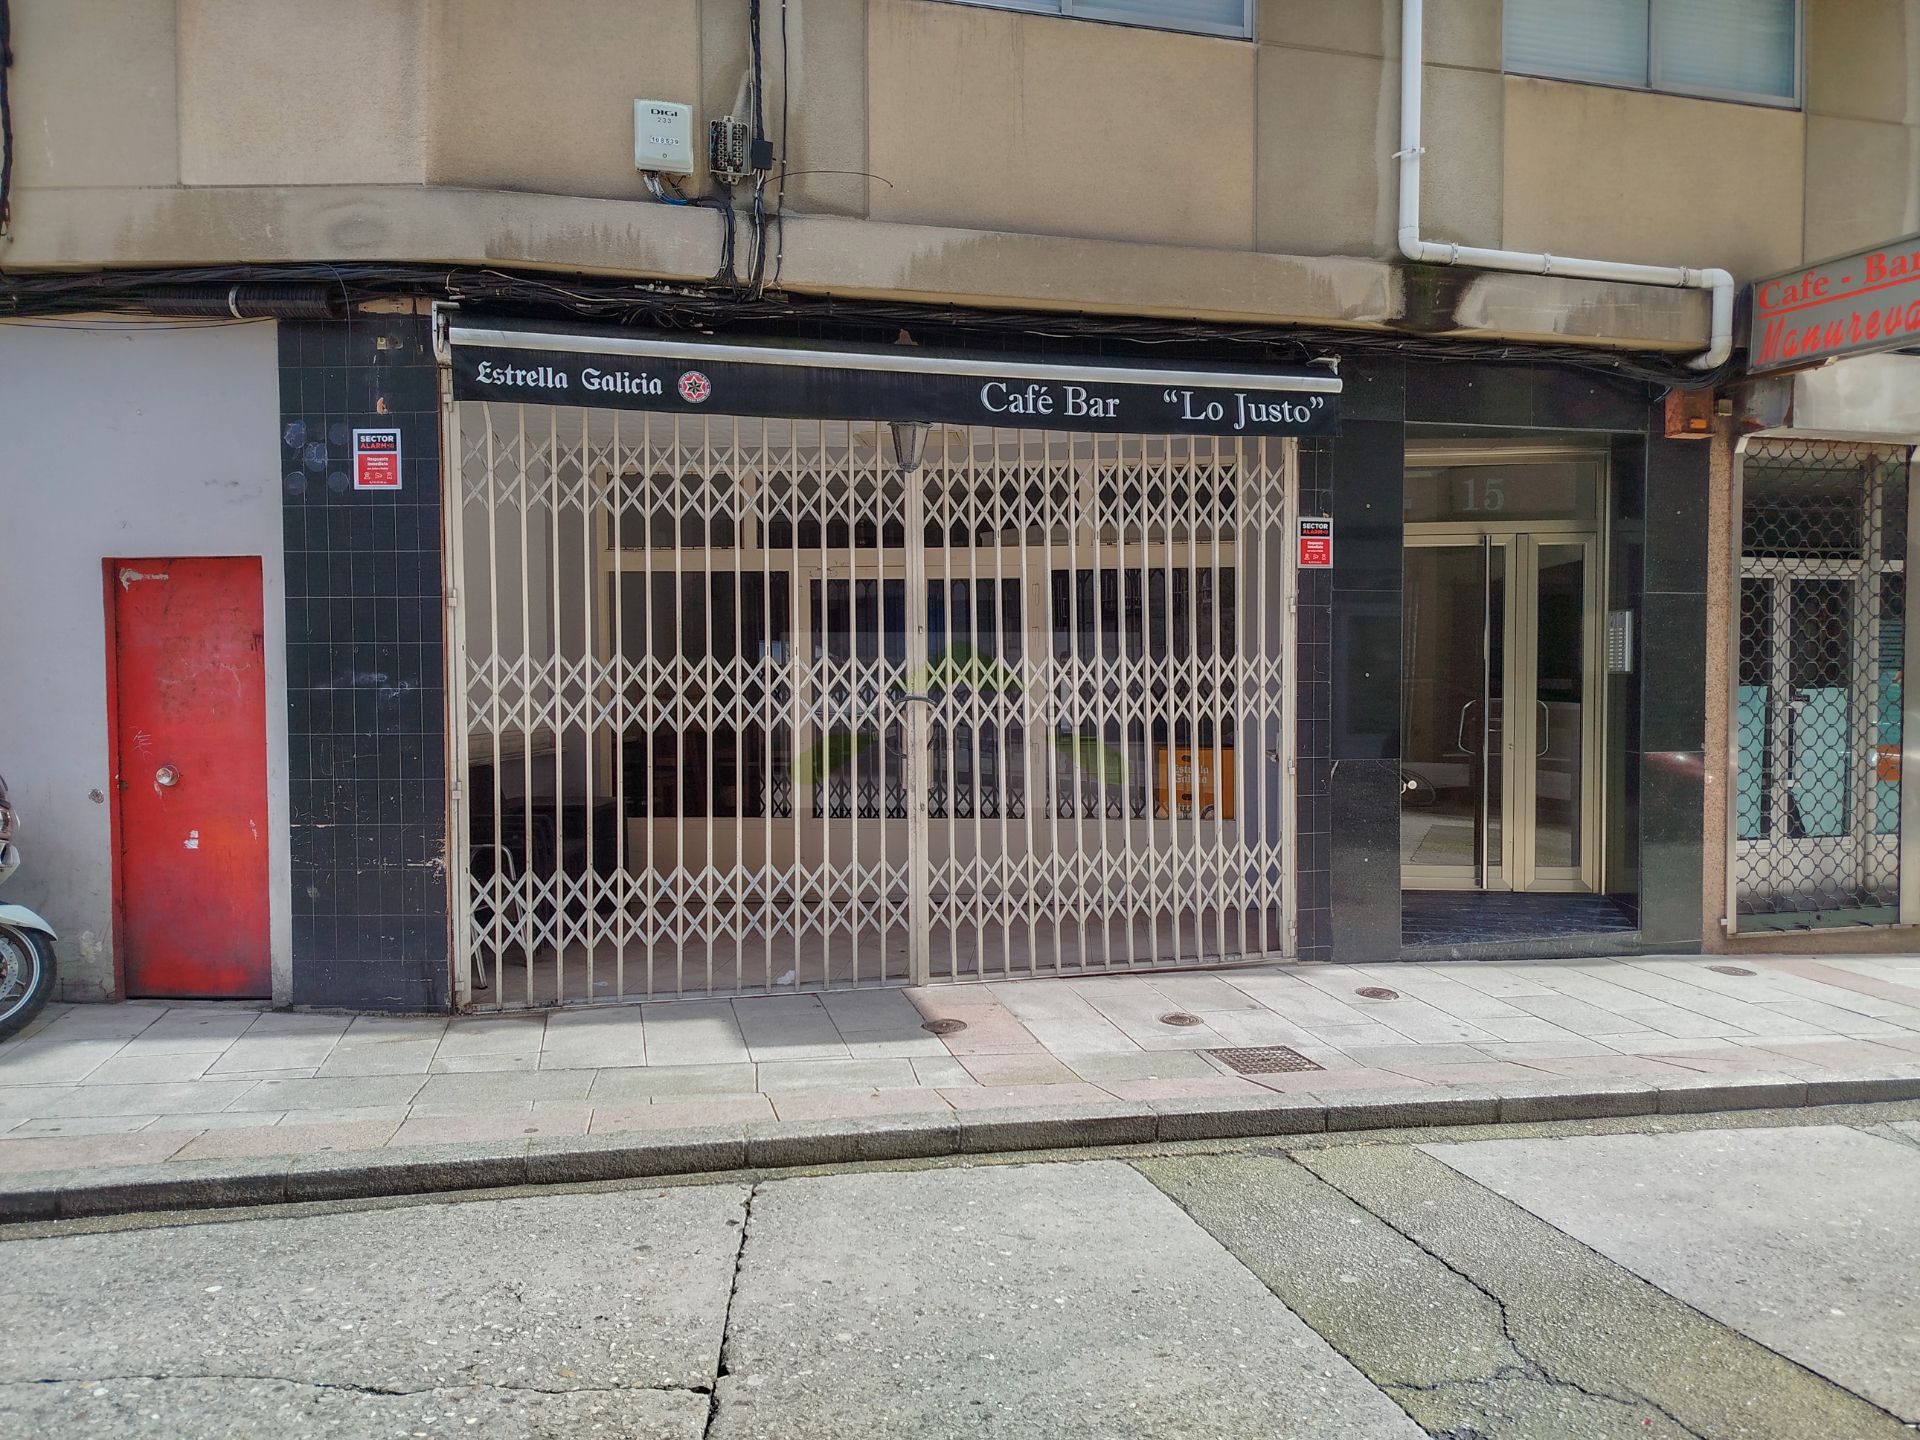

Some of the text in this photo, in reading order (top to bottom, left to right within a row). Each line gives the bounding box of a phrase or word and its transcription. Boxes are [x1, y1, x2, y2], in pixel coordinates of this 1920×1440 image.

[651, 108, 678, 117] DIGI
[1759, 270, 1829, 310] Cafe
[475, 360, 568, 389] Estrella
[581, 367, 663, 395] Galicia
[980, 381, 1053, 415] Café
[1063, 385, 1120, 418] Bar
[360, 435, 394, 443] SECTOR
[1462, 478, 1505, 511] 15
[1302, 522, 1329, 530] SECTOR
